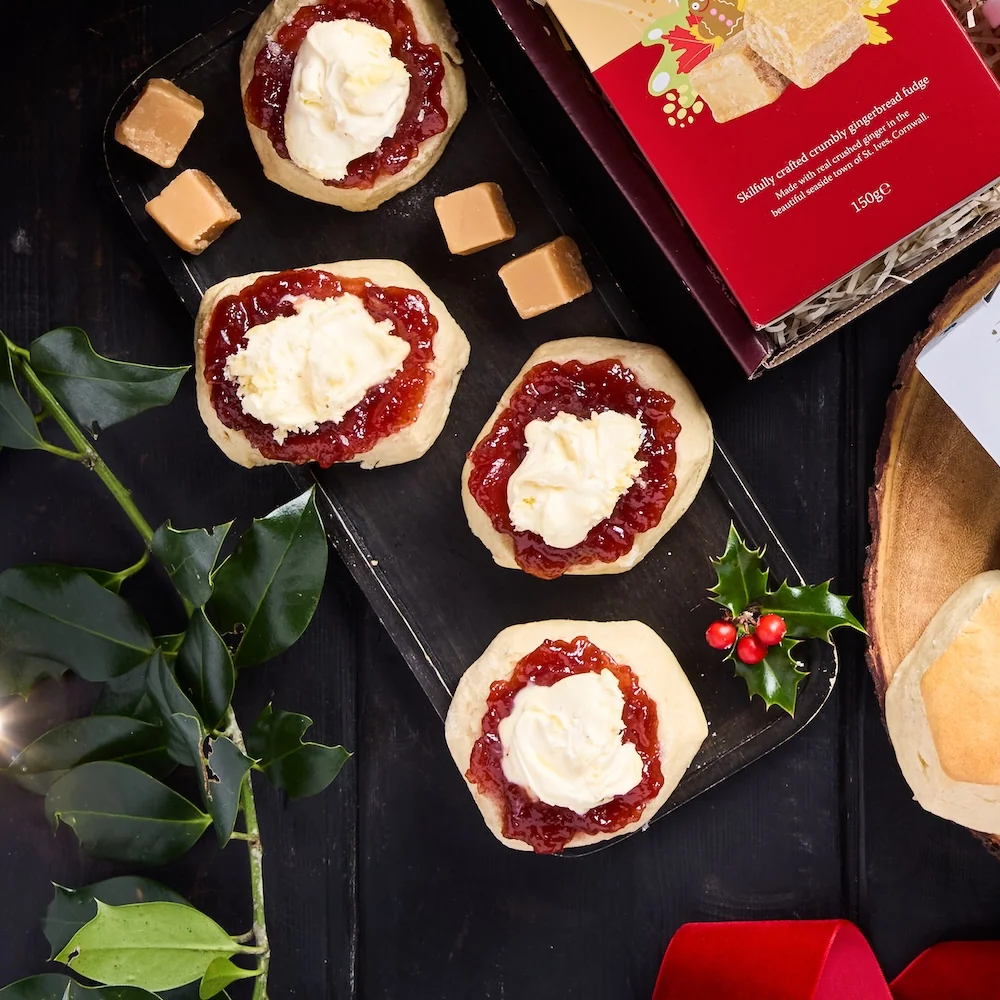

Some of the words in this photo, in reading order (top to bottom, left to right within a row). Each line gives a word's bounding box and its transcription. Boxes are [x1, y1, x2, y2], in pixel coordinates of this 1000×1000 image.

[736, 175, 775, 203] Skilfully
[775, 152, 809, 179] crafted
[808, 128, 847, 158] crumbly
[848, 91, 903, 135] gingerbread
[901, 76, 930, 97] fudge
[770, 190, 806, 217] beautiful
[805, 174, 833, 196] seaside
[832, 162, 854, 178] town
[853, 153, 863, 165] of
[861, 149, 874, 159] St.
[873, 137, 893, 152] Ives,
[891, 112, 930, 139] Cornwall.
[775, 182, 799, 200] Made
[798, 170, 816, 185] with
[816, 159, 832, 174] real
[831, 139, 863, 164] crushed
[862, 125, 887, 146] ginger
[886, 120, 896, 128] in
[895, 110, 910, 122] the
